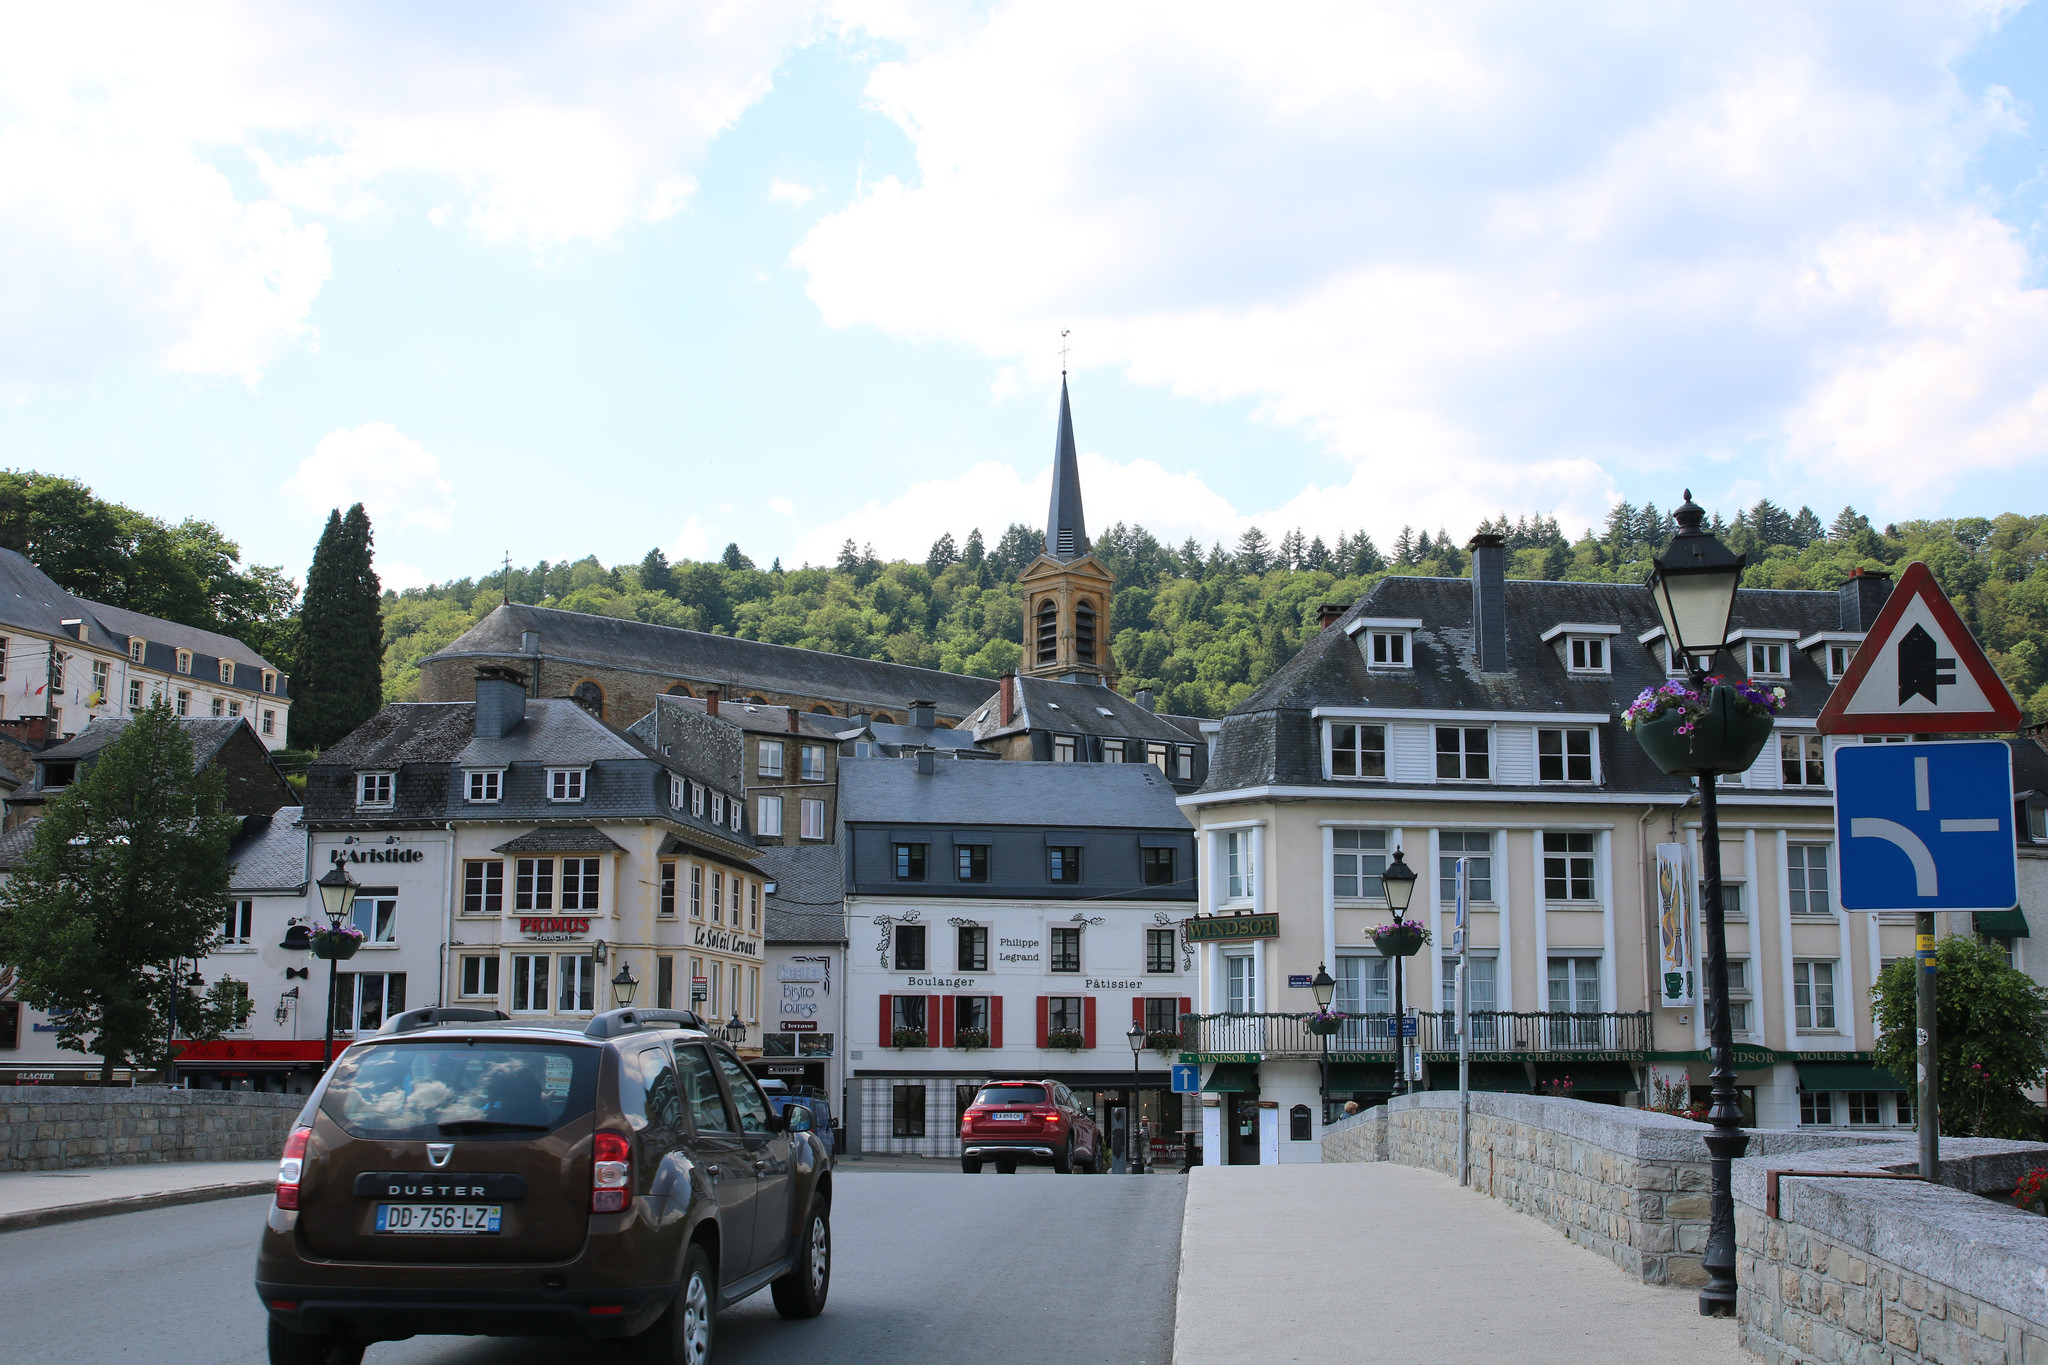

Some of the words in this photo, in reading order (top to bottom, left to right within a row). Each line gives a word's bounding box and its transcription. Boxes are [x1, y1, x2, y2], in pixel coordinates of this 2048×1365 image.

[331, 848, 423, 863] L'Aristide
[520, 917, 590, 933] PRIMUS
[1188, 919, 1275, 937] WINDSOR
[694, 926, 705, 945] Le
[706, 929, 731, 951] Soleil
[732, 934, 757, 956] Levant
[1000, 938, 1039, 948] Philippe
[999, 953, 1039, 962] Legrand
[907, 976, 975, 988] Boulanger
[1085, 978, 1143, 989] Pâtissier
[783, 984, 815, 1001] Bistro
[781, 1000, 818, 1018] Lounge
[227, 1046, 236, 1058] &
[1587, 1053, 1645, 1062] GAUFRES
[1797, 1052, 1847, 1061] MOULES
[1198, 1054, 1247, 1063] WINDSOR
[388, 1185, 485, 1196] DUSTER
